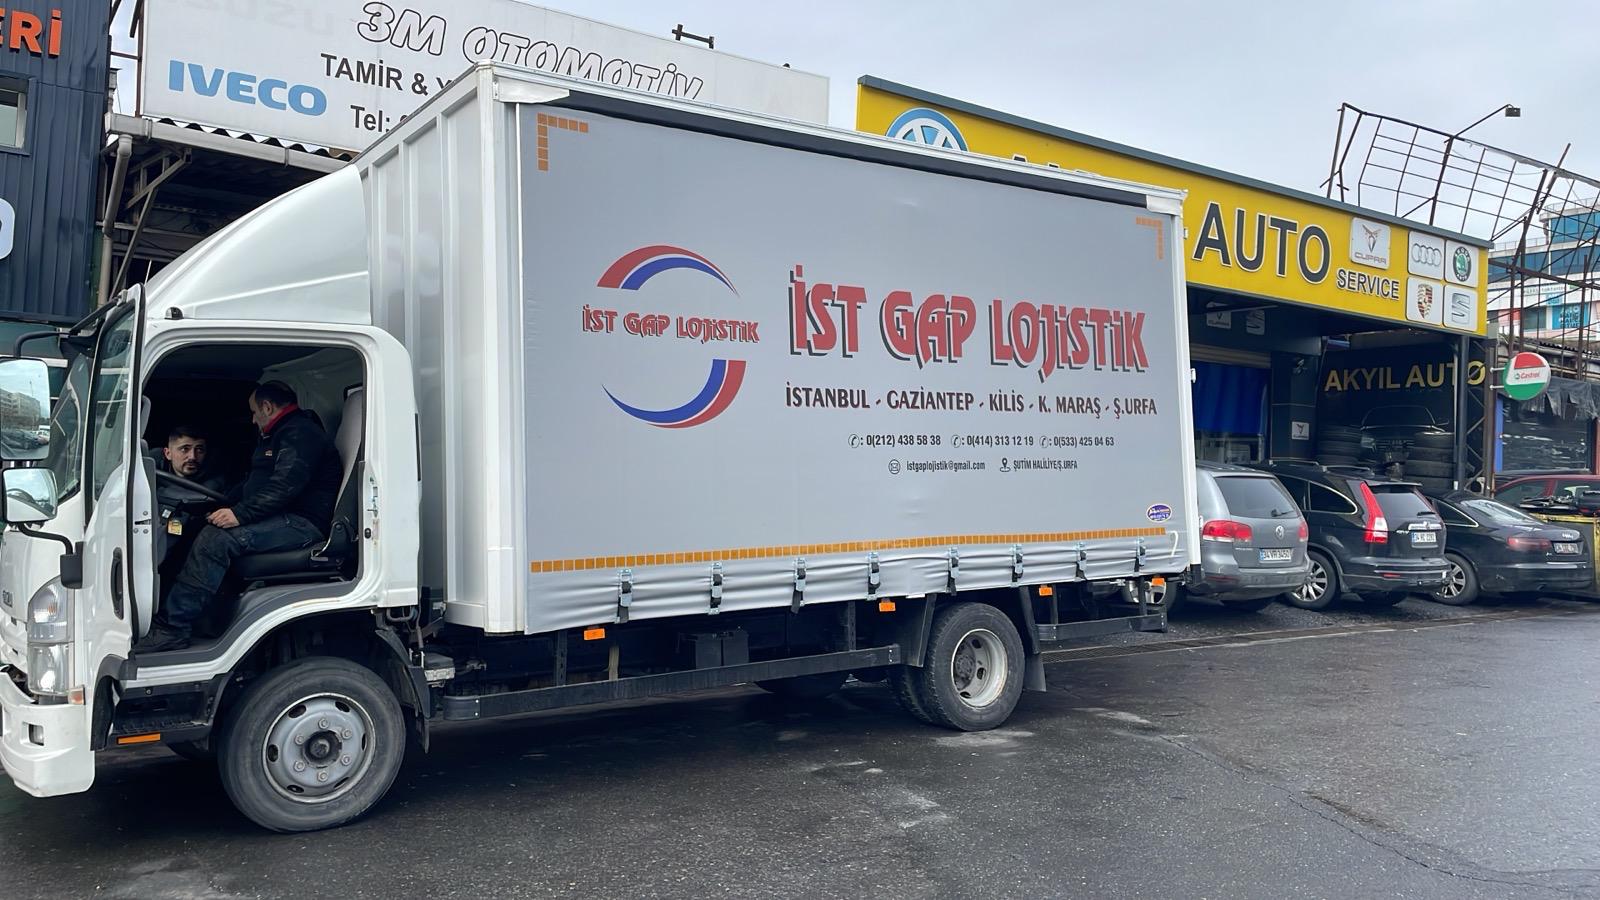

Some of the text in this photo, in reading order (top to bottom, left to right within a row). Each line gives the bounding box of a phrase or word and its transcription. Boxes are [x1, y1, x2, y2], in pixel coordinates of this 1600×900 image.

[0, 7, 62, 55] Rİ
[356, 2, 447, 56] 3M
[168, 60, 328, 116] IVECO
[320, 53, 403, 91] TAMİR
[411, 73, 429, 96] &
[350, 105, 390, 133] Tel:
[1192, 201, 1331, 285] AUTO
[1336, 269, 1400, 300] SERVICE
[623, 312, 670, 337] GAP
[788, 264, 867, 358] İST
[879, 290, 977, 369] GAP
[1324, 360, 1486, 392] AKYIL AUTO
[785, 381, 870, 409] İSTANBUL
[886, 386, 974, 411] GAZİANTEP
[989, 389, 1024, 412] KİLİS
[1039, 396, 1051, 413] K.
[1056, 397, 1101, 419] MARAŞ
[1114, 398, 1157, 419] Ş.URFA
[897, 435, 914, 446] 438
[917, 435, 928, 446] 58
[930, 435, 941, 446] 38
[994, 436, 1010, 446] 313
[1012, 436, 1022, 446] 12
[1024, 436, 1034, 446] 19
[1079, 437, 1092, 447] 425
